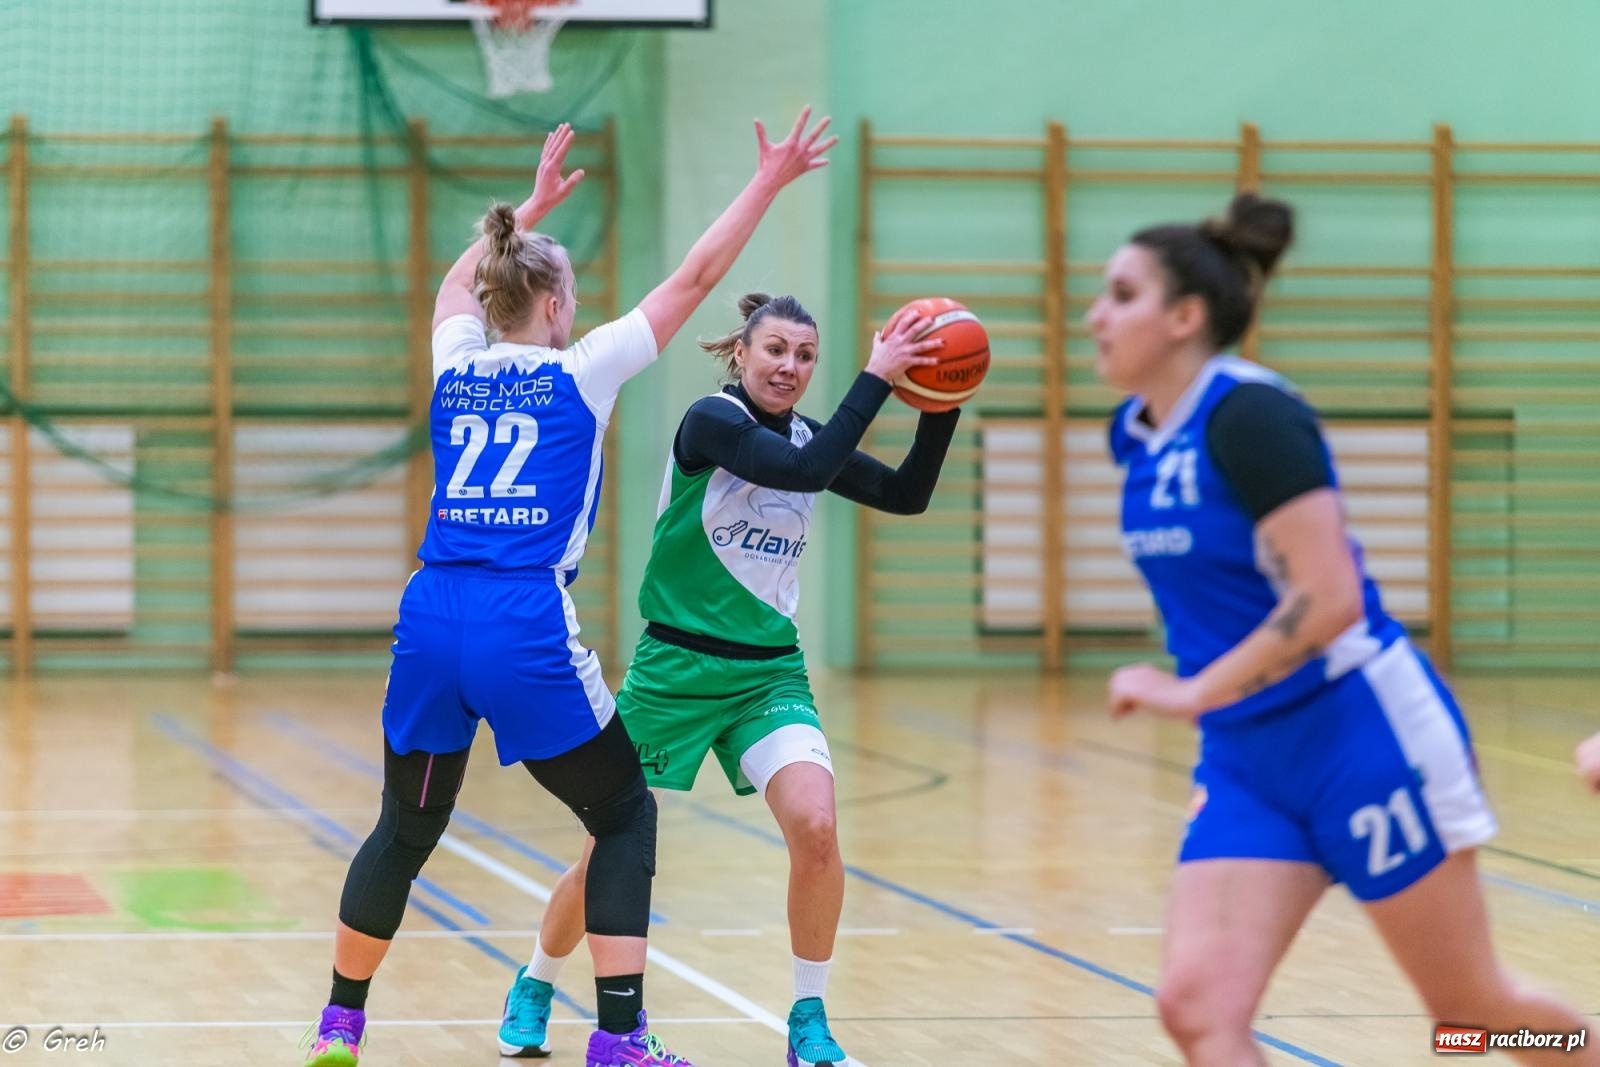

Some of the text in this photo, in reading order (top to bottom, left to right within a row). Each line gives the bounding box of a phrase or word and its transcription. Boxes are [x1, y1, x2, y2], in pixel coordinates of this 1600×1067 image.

[440, 393, 554, 411] WROCŁAW
[442, 376, 554, 397] MKS MOS
[446, 412, 539, 499] 22
[1150, 448, 1200, 508] 21
[1349, 786, 1428, 876] 21
